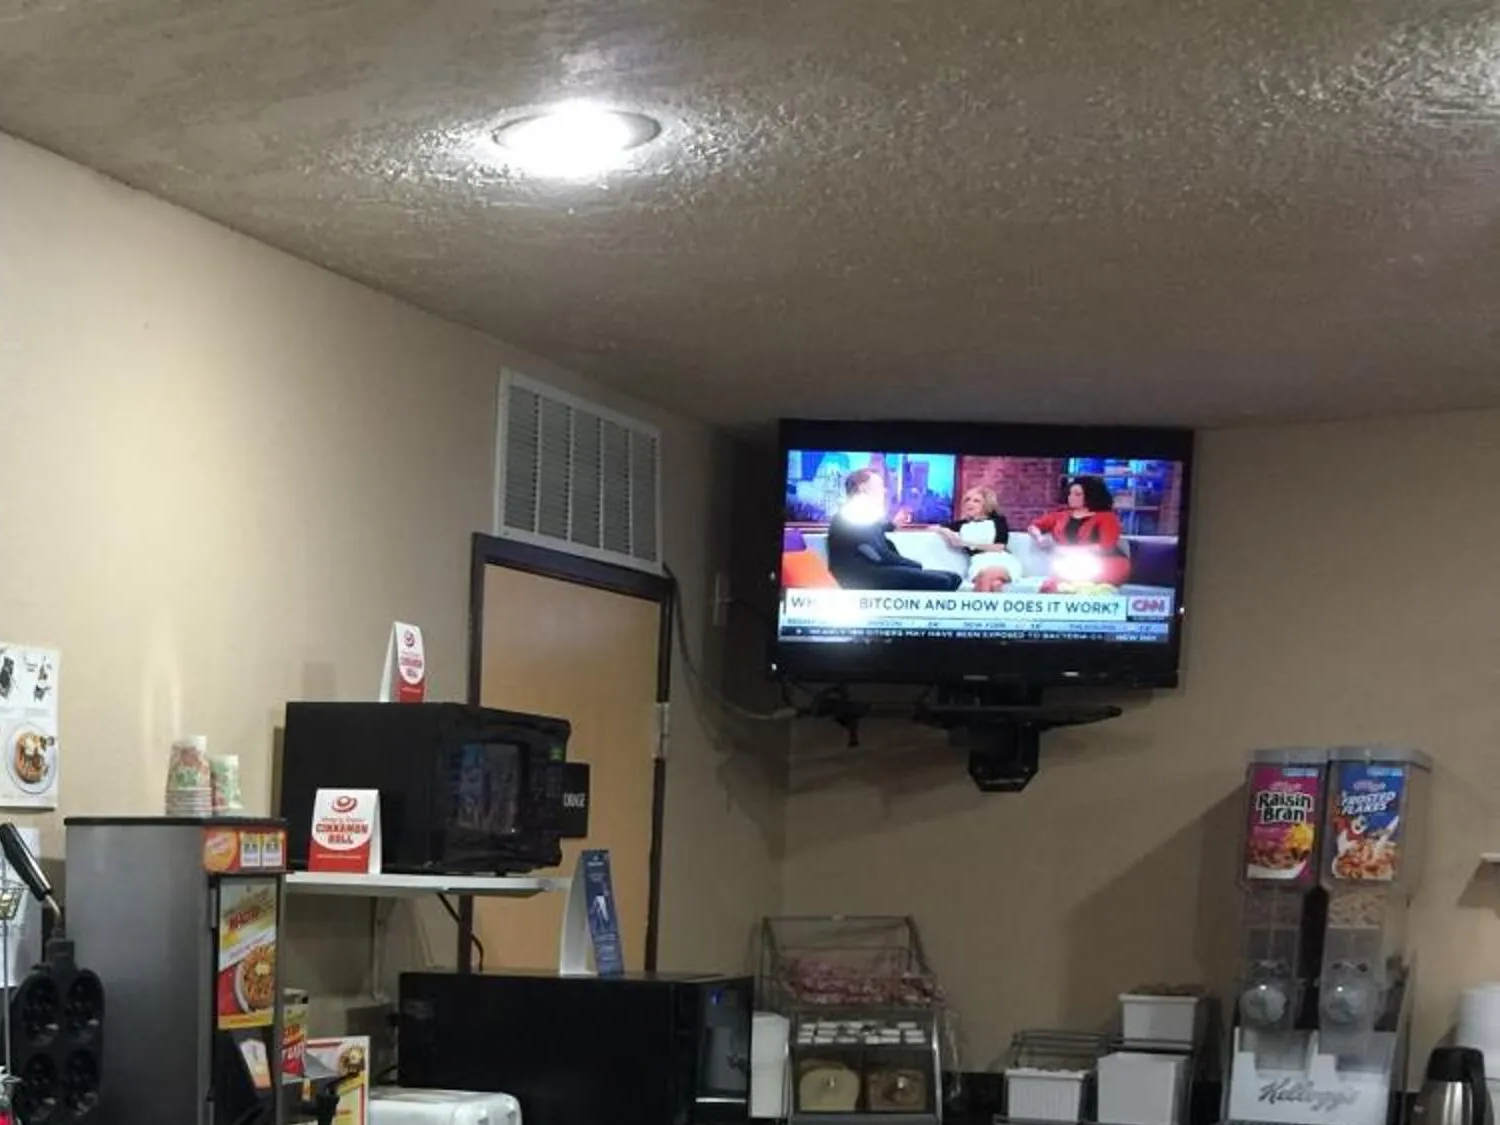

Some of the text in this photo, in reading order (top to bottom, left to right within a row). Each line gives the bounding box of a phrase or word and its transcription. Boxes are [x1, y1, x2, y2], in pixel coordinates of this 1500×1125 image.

[858, 597, 920, 610] BITCOIN
[925, 598, 957, 611] AND
[961, 599, 999, 612] HOW
[1003, 600, 1043, 612] DOES
[1047, 600, 1061, 612] IT
[1065, 601, 1120, 613] WORK?
[1132, 599, 1165, 612] CNN
[1257, 791, 1312, 810] Raisin
[1263, 806, 1306, 822] Bran
